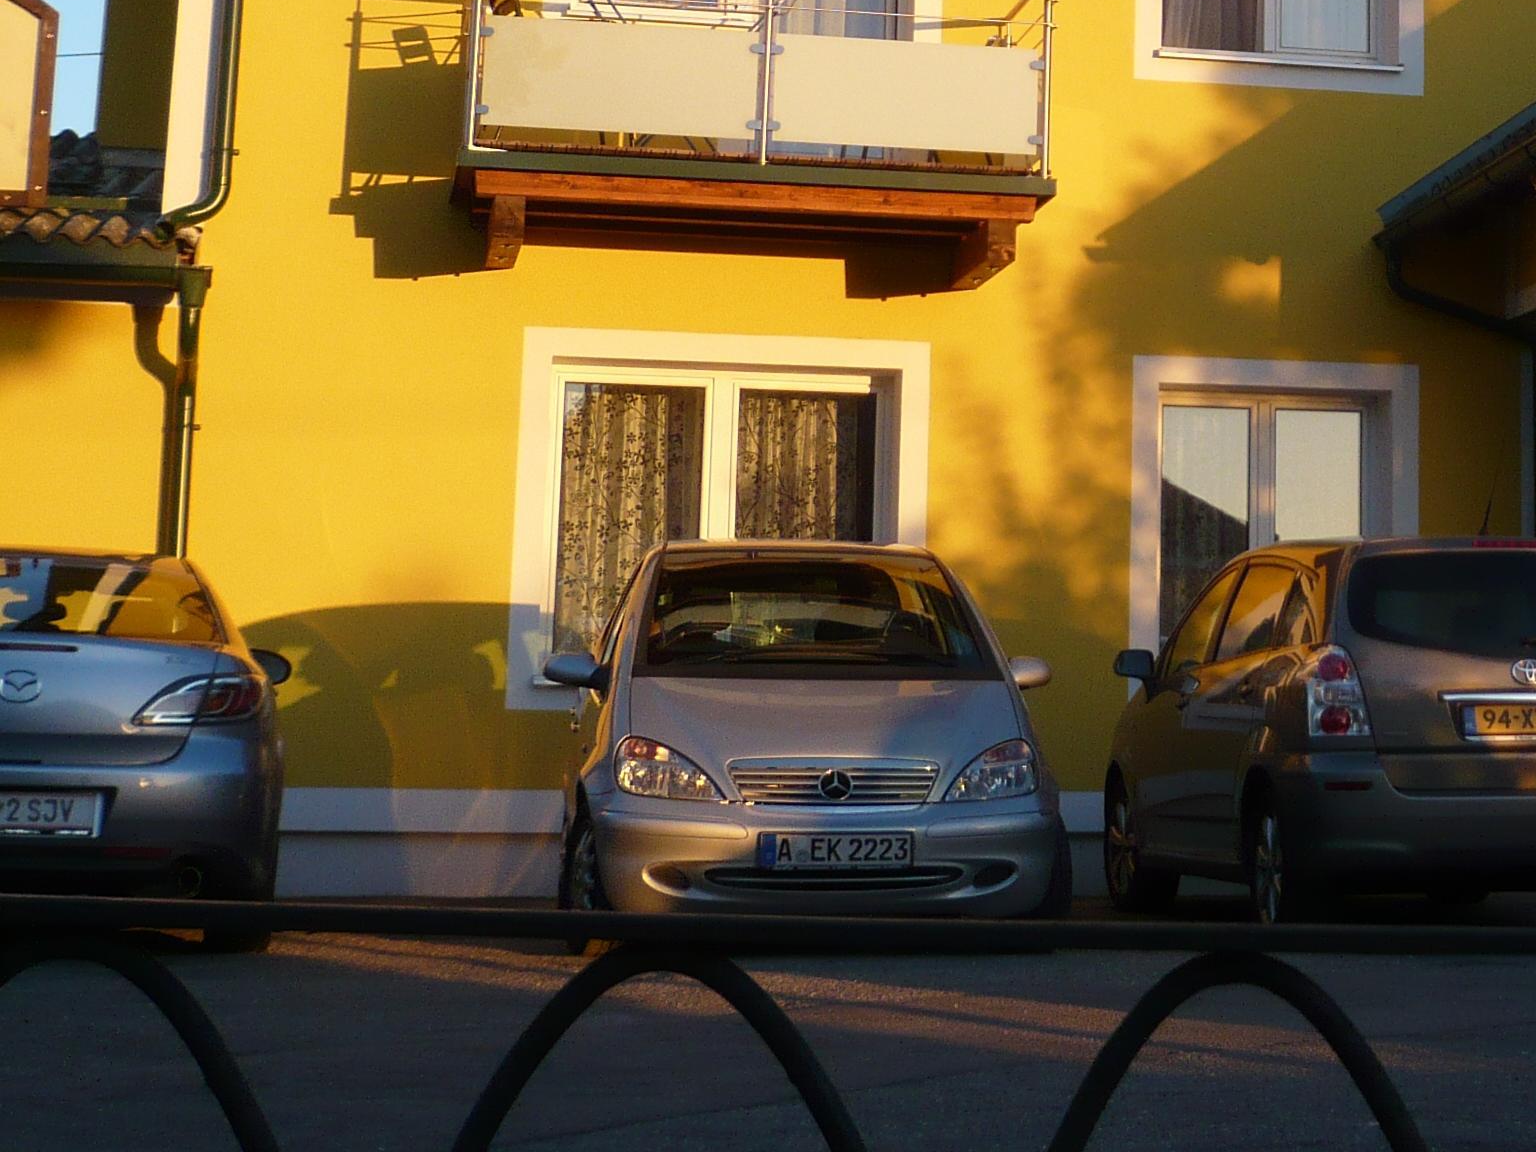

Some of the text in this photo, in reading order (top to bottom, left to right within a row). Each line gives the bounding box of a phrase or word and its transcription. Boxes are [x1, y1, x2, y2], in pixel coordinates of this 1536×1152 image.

[27, 797, 74, 823] SJV
[810, 837, 842, 862] EK
[848, 837, 908, 862] 2223
